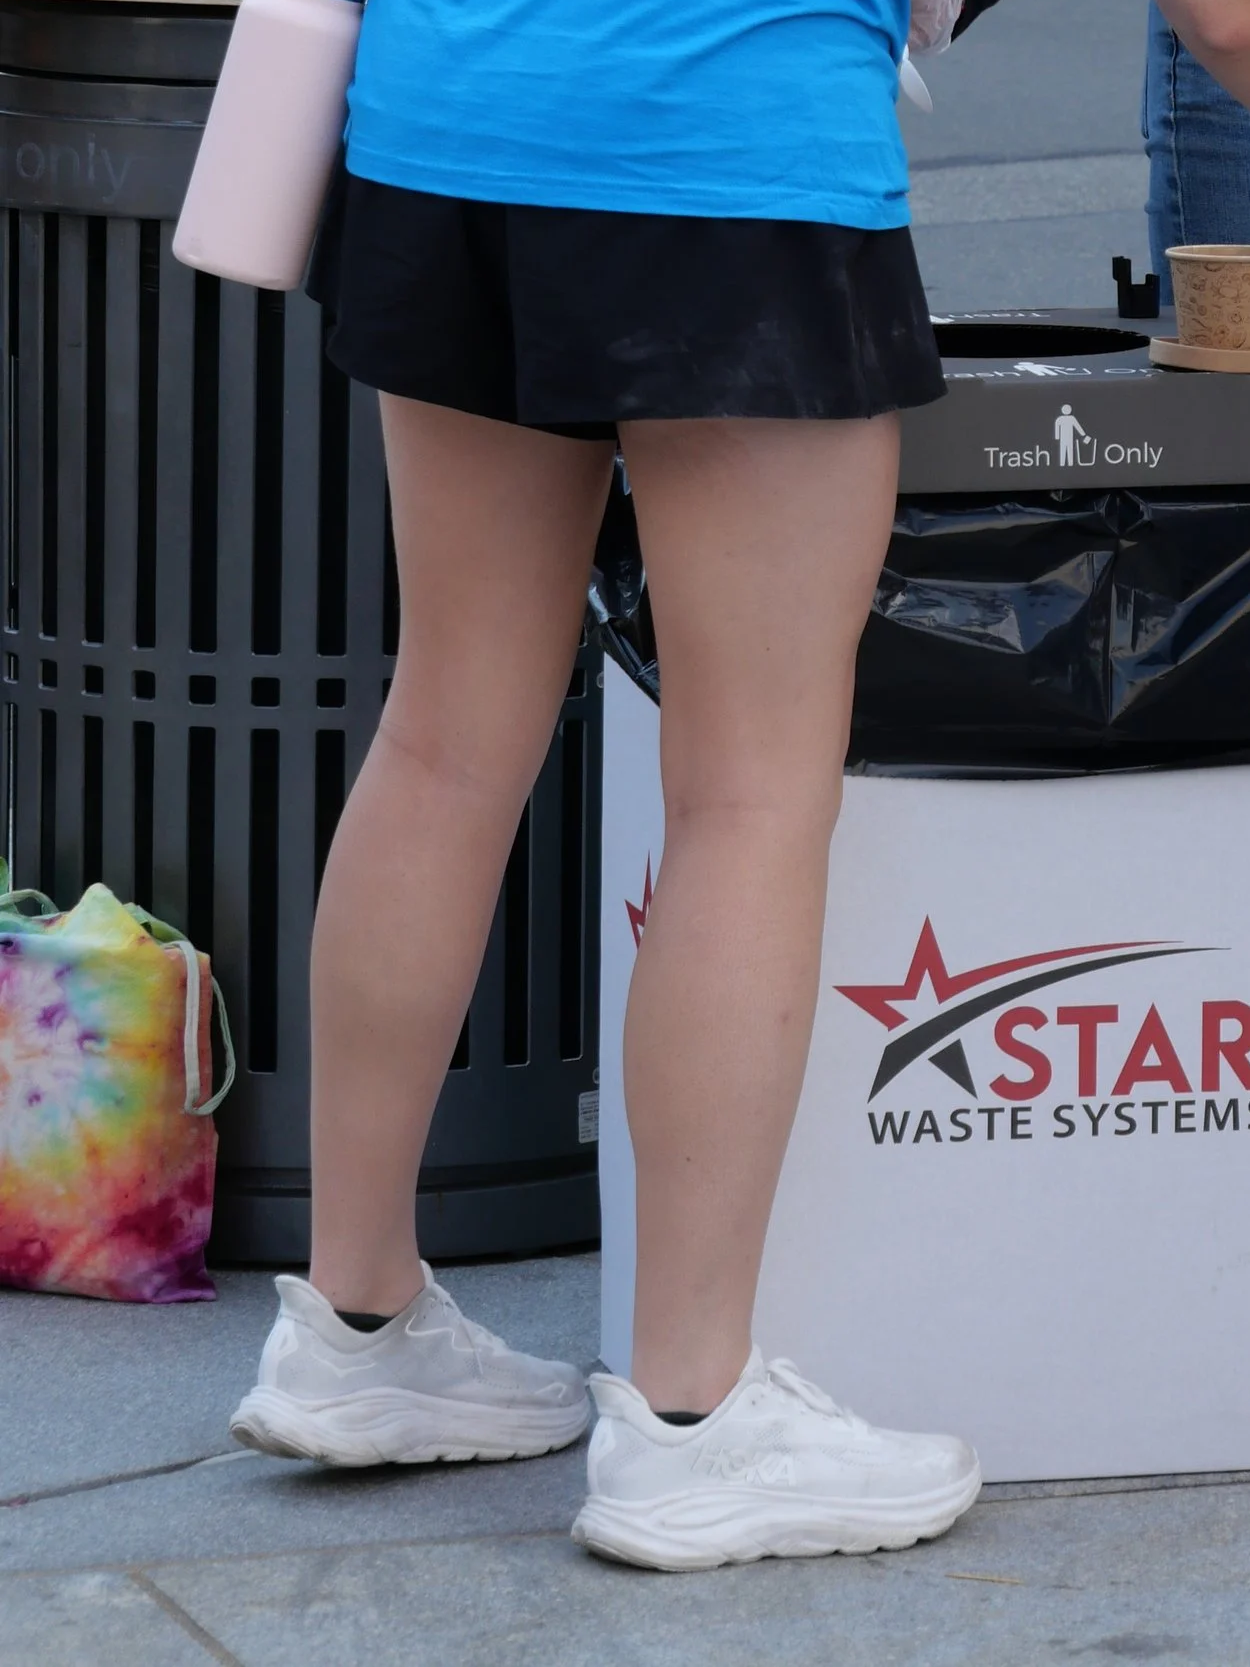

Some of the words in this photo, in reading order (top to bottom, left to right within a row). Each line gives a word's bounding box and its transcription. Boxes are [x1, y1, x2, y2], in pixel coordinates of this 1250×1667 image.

[15, 133, 132, 204] only
[943, 369, 1021, 378] rash
[984, 445, 1051, 469] Trash
[1104, 441, 1164, 469] Only
[867, 1106, 1033, 1145] WASTE
